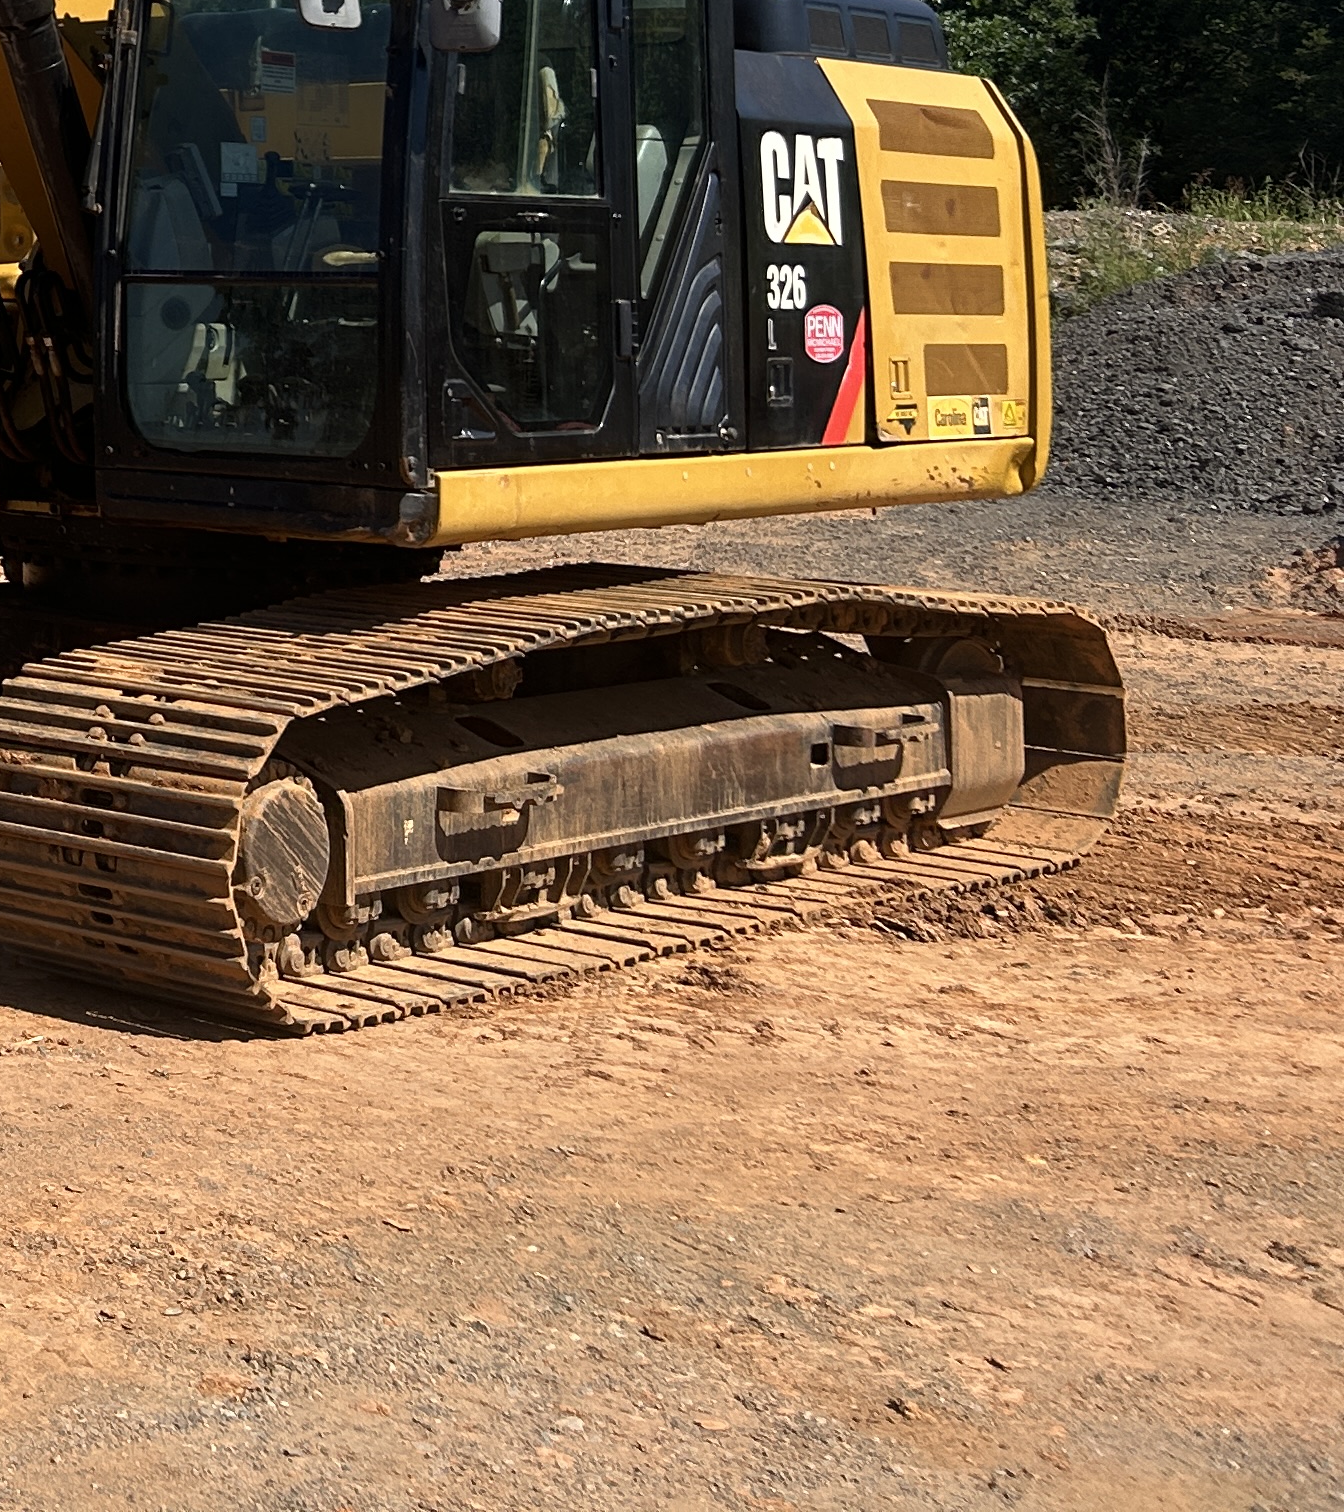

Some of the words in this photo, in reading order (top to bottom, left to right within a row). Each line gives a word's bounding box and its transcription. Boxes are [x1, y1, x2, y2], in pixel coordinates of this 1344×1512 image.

[760, 130, 844, 246] CAT
[766, 264, 807, 310] 326
[767, 317, 777, 350] L
[807, 315, 841, 338] PENN
[934, 407, 967, 427] Carolina
